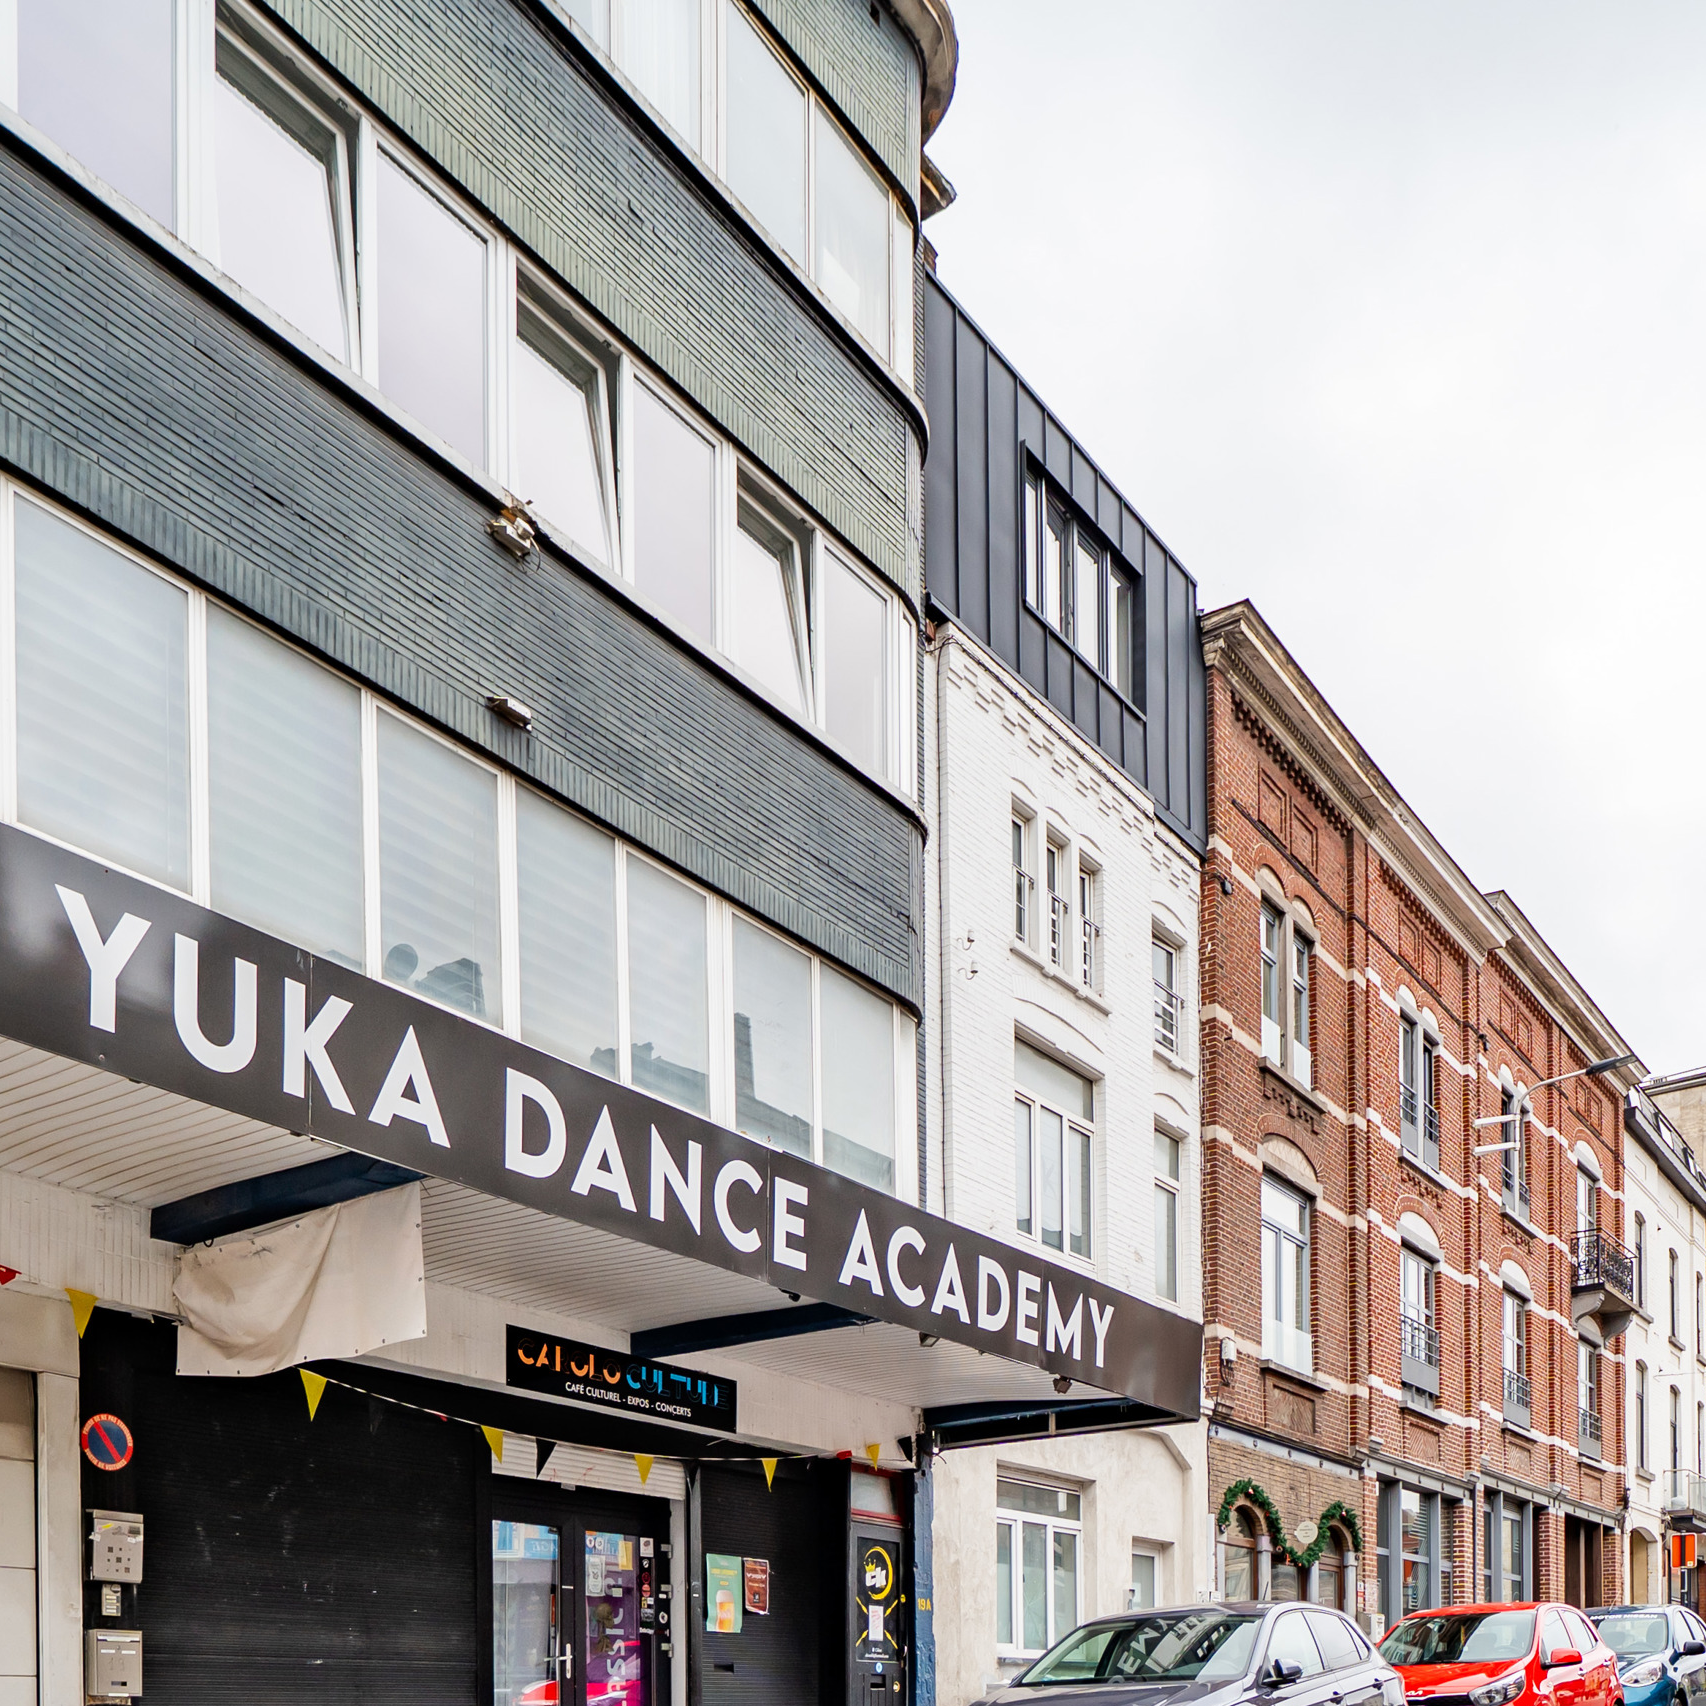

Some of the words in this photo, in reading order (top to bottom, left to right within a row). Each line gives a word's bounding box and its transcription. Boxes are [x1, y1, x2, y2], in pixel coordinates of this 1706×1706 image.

[54, 883, 451, 1149] YUKA
[504, 1066, 807, 1271] DANCE
[837, 1207, 1115, 1368] ACADEMY
[518, 1338, 621, 1385] CAROLO
[626, 1363, 730, 1410] CULTURE
[565, 1381, 584, 1395] CAFÉ
[586, 1386, 621, 1402] CULTUREL
[627, 1395, 650, 1409] EXPOS
[656, 1401, 692, 1417] CONCERTS
